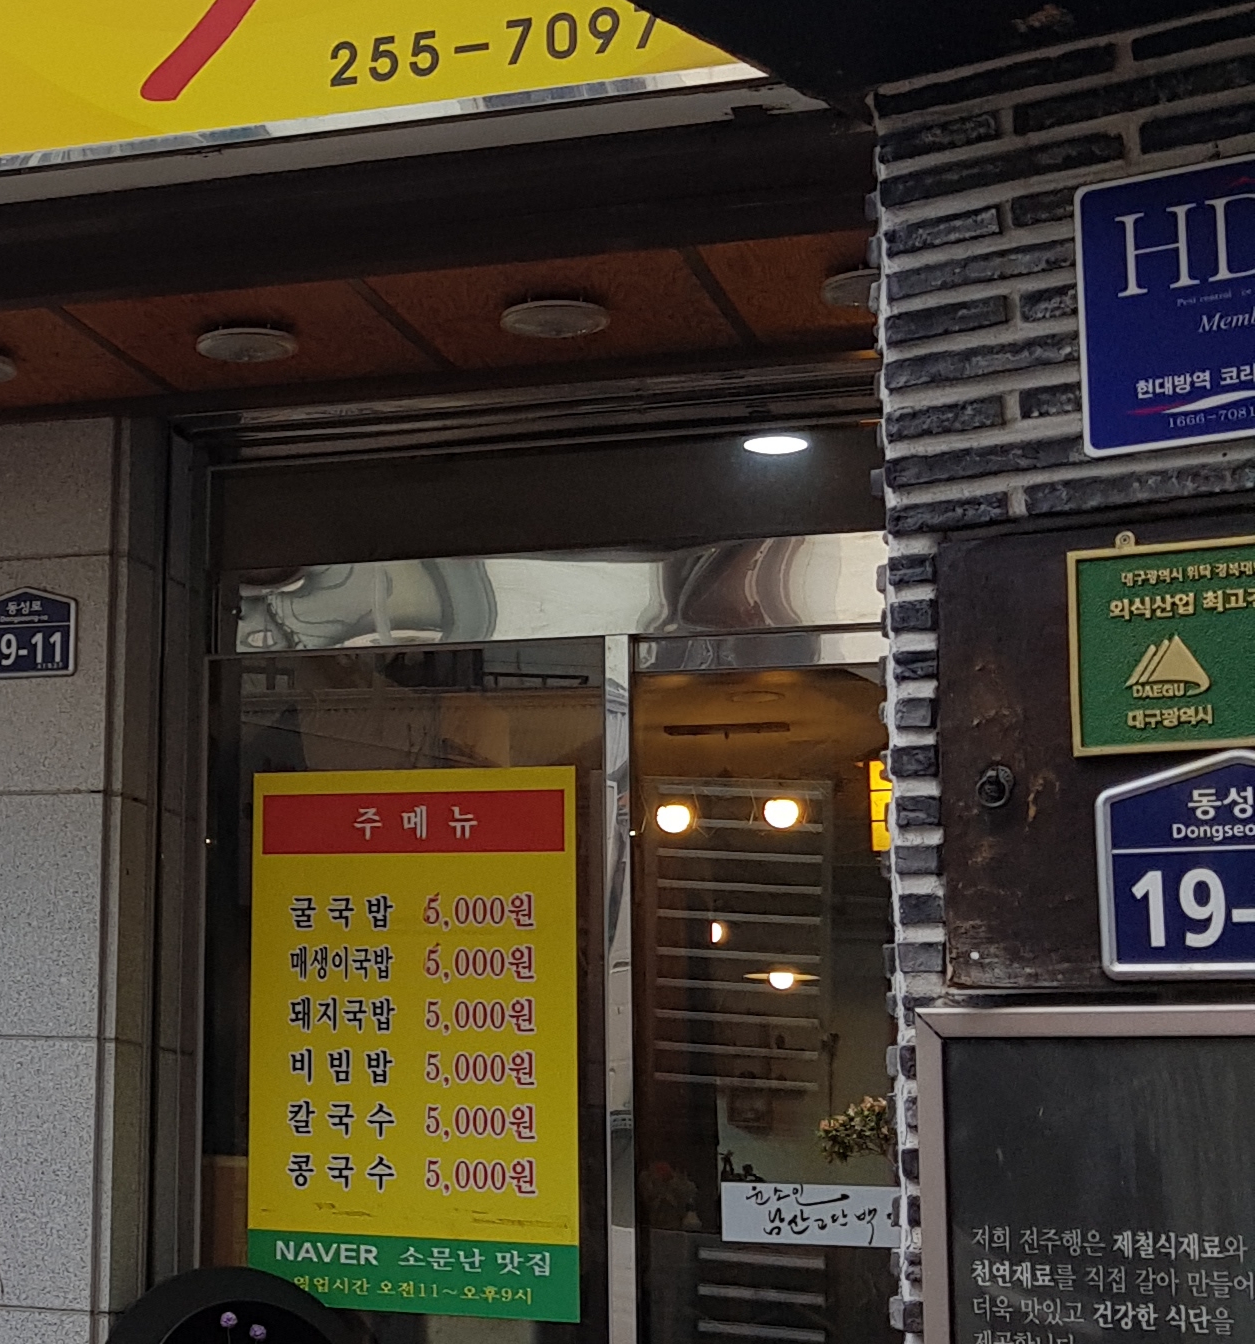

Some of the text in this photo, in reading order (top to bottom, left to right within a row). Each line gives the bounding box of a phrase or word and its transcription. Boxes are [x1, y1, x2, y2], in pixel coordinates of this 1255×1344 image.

[328, 5, 657, 88] 255-7097
[1136, 369, 1211, 399] 현대방역
[1169, 406, 1255, 428] 1666-7081
[1121, 561, 1255, 586] 대구광역시 위탁 경북대
[6, 601, 42, 615] 동성로
[1110, 592, 1194, 620] 외식산업
[1133, 683, 1185, 698] DAEGU
[1127, 705, 1213, 729] 대구광역시
[1187, 786, 1254, 820] 동성
[1172, 823, 1255, 841] Dongseo
[1131, 868, 1255, 948] 19-
[290, 945, 394, 981] 매생이국밥
[289, 996, 536, 1034] 돼지국밥 5,000원
[425, 1051, 536, 1087] 5,000원
[426, 1105, 536, 1141] 5,000원
[426, 1158, 536, 1195] 5,000원
[275, 1241, 550, 1277] NAVER 소문난 맛집
[971, 1225, 1248, 1263] 저희 전주행은 제철식재료와
[293, 1276, 371, 1296] 영업시간
[971, 1259, 1255, 1301] 천연재료를 직접 갈아 만들어
[973, 1294, 1235, 1336] 더욱 맛있고 건강한 식단을
